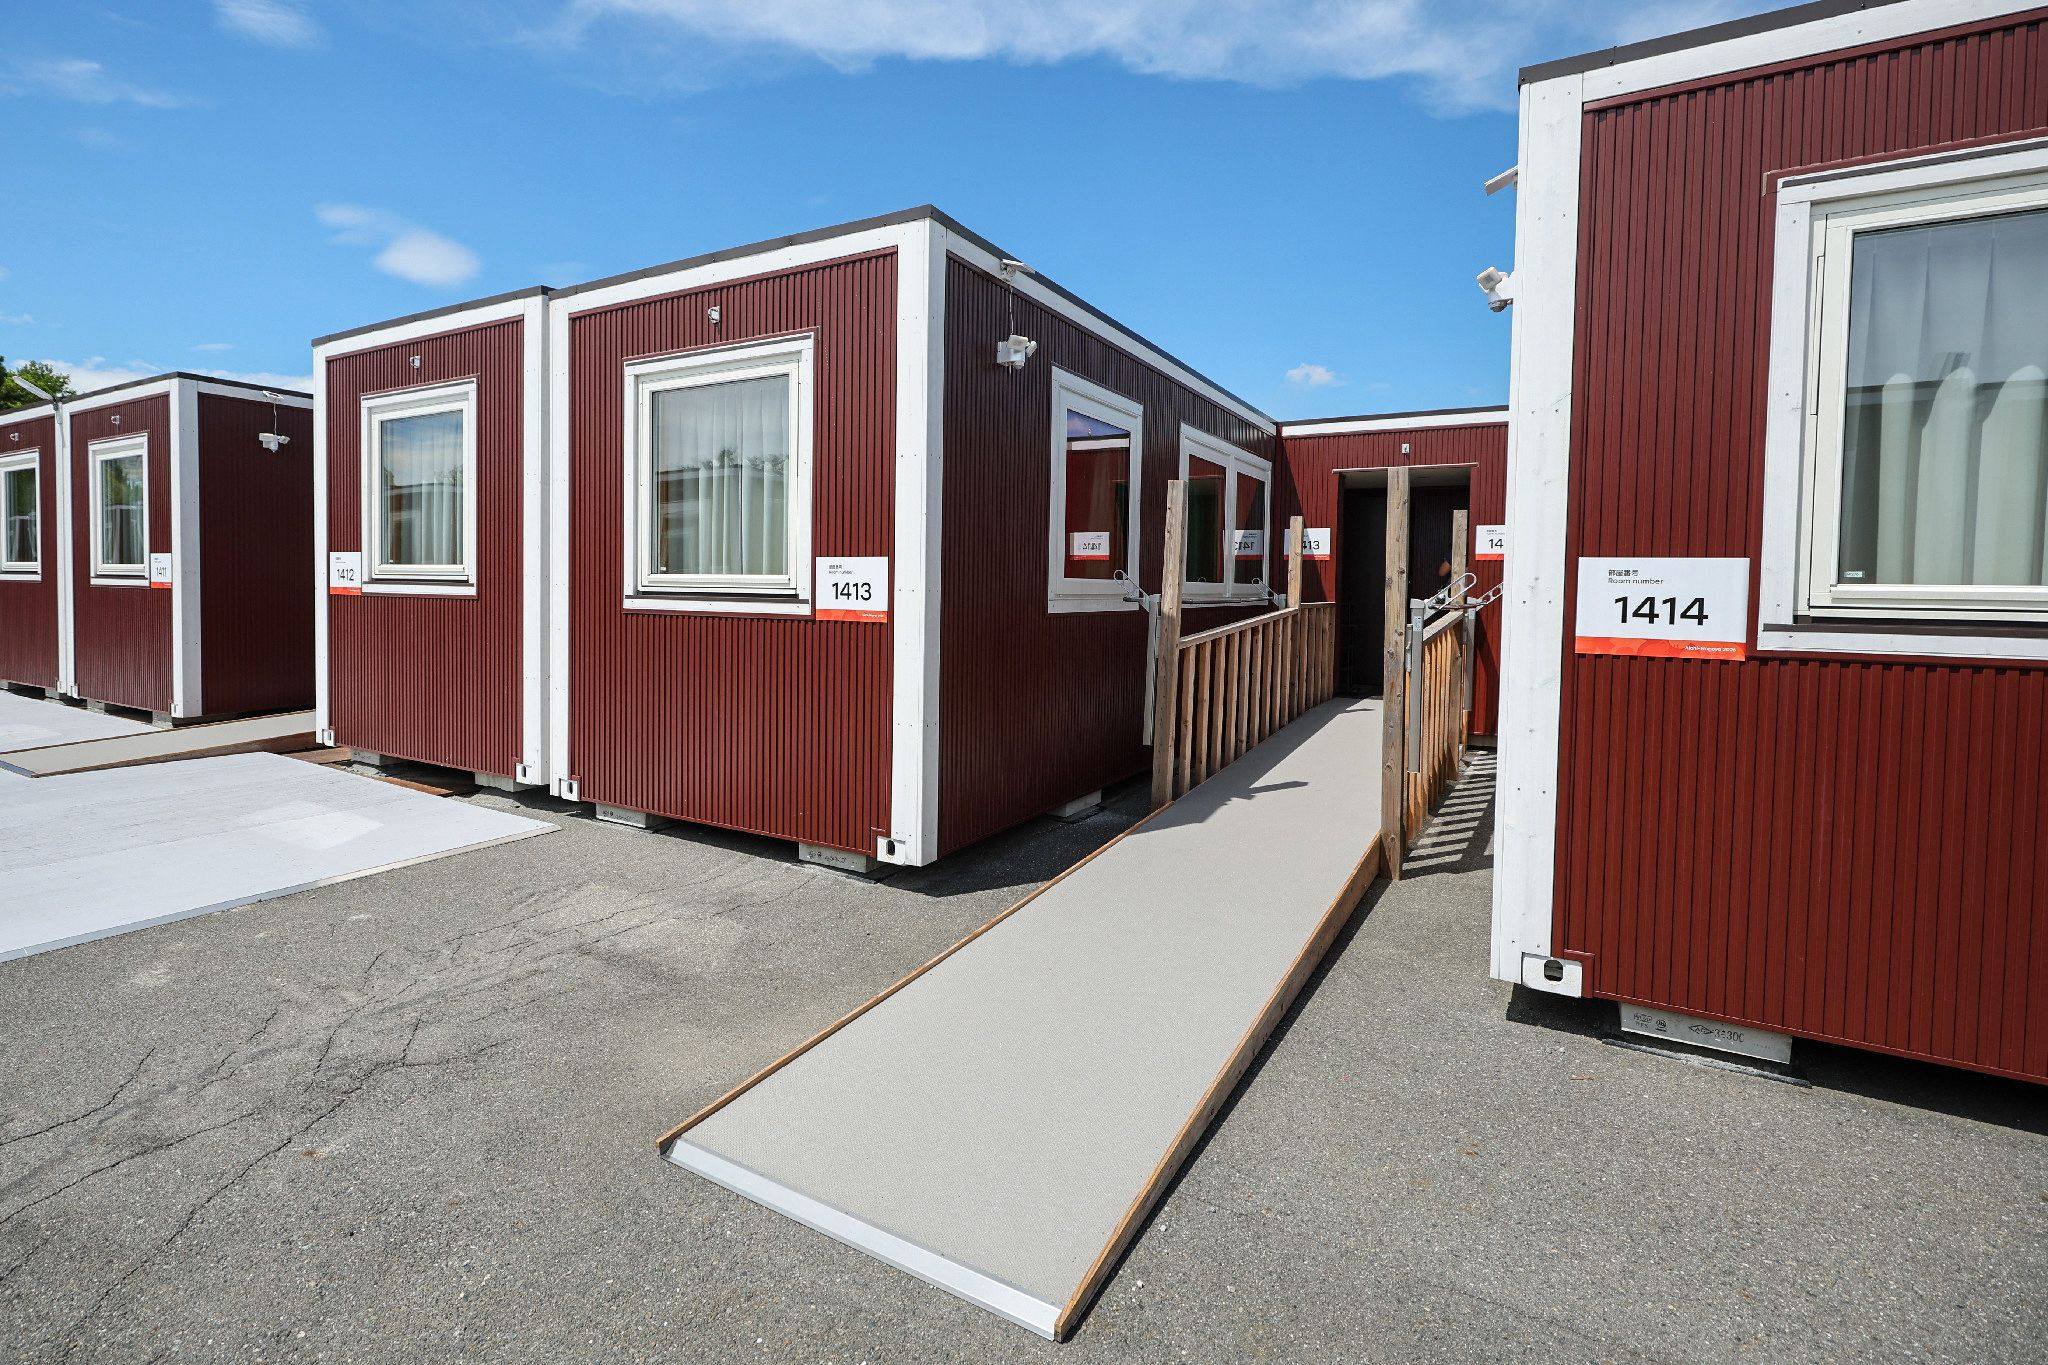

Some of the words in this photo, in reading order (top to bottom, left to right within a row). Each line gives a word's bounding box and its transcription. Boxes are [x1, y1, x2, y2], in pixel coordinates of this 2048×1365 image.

[1302, 540, 1320, 550] 413
[1489, 538, 1504, 549] 14
[336, 568, 355, 581] 1412
[831, 582, 872, 601] 1413
[1614, 596, 1709, 626] 1414
